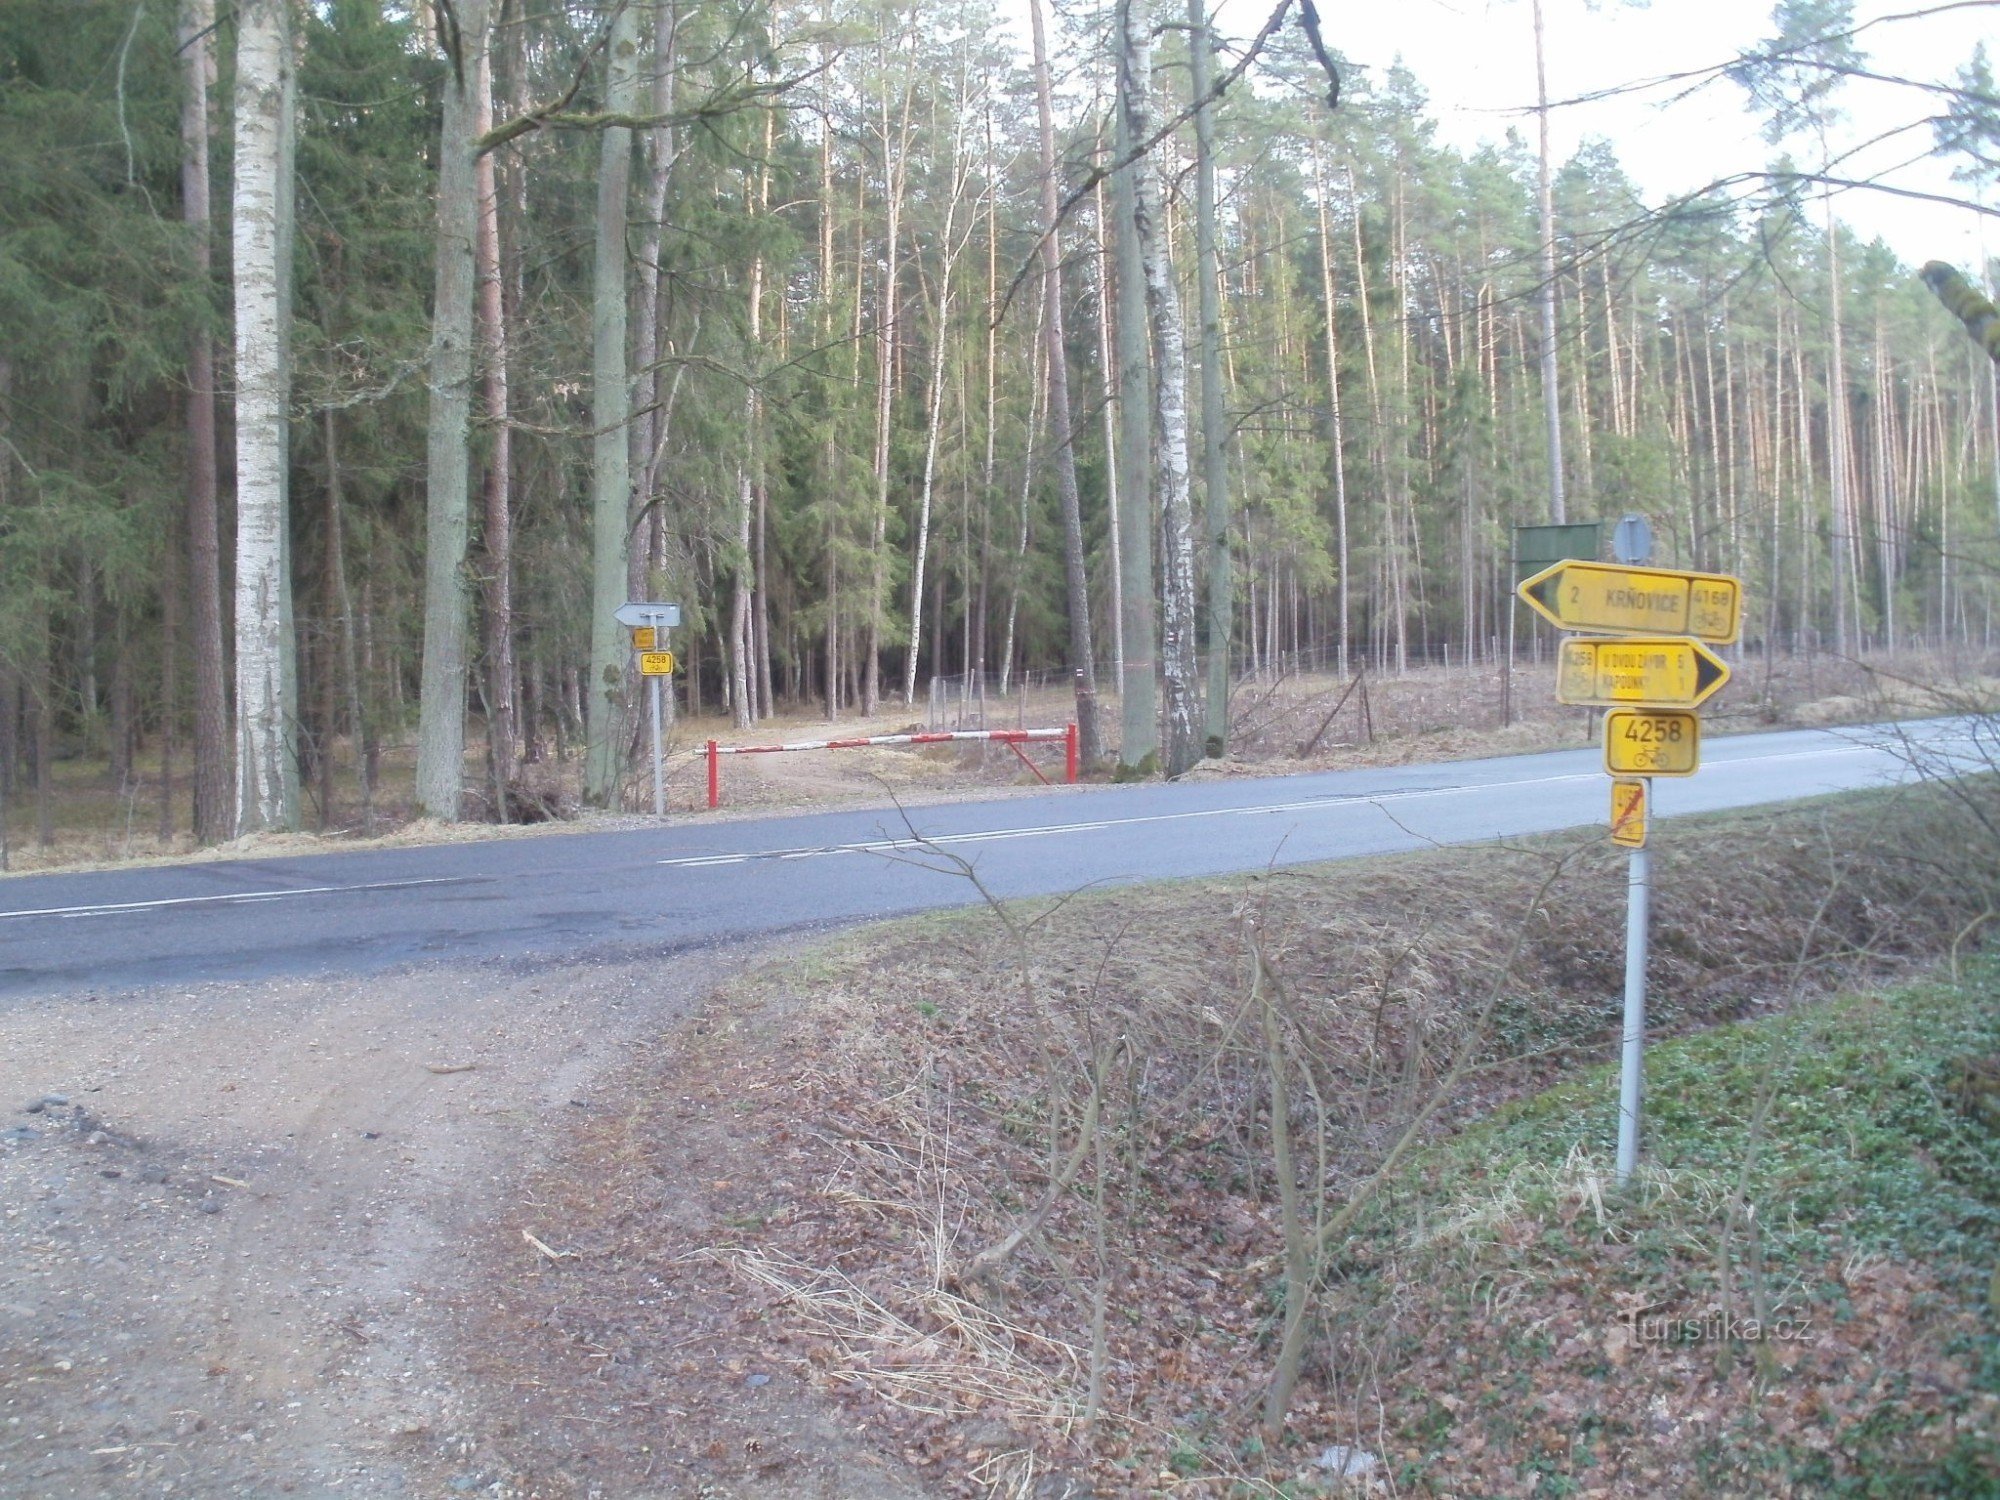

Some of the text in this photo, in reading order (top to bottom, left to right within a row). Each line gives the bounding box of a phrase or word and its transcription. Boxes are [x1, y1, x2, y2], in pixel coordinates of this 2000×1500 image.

[1571, 586, 1680, 613] 2 KRŇOVICE
[1693, 589, 1729, 606] 4168
[646, 655, 667, 664] 4258
[1625, 719, 1681, 742] 4258
